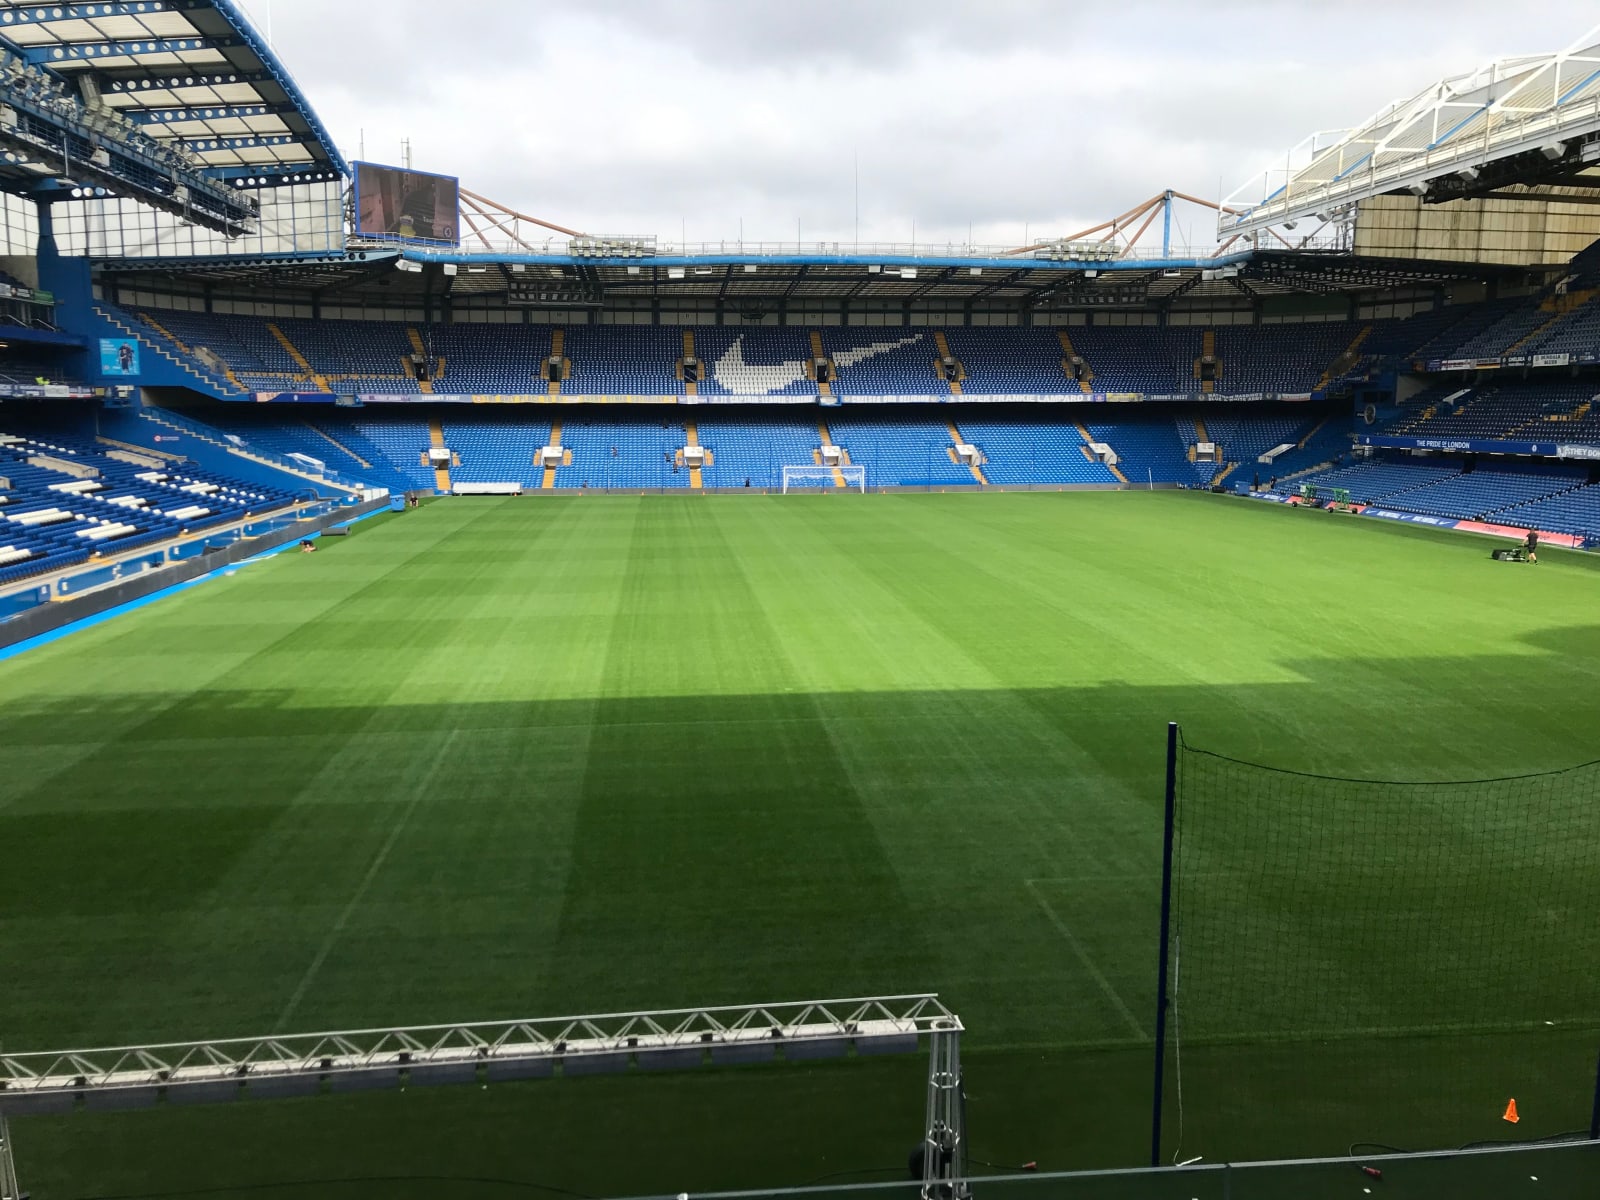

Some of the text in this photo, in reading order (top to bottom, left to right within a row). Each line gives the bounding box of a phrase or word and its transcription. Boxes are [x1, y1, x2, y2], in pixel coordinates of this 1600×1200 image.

[958, 394, 1084, 402] SUPER FRANKIE LAMPARD
[1426, 440, 1441, 448] PRIDE
[1447, 441, 1470, 449] LONDON
